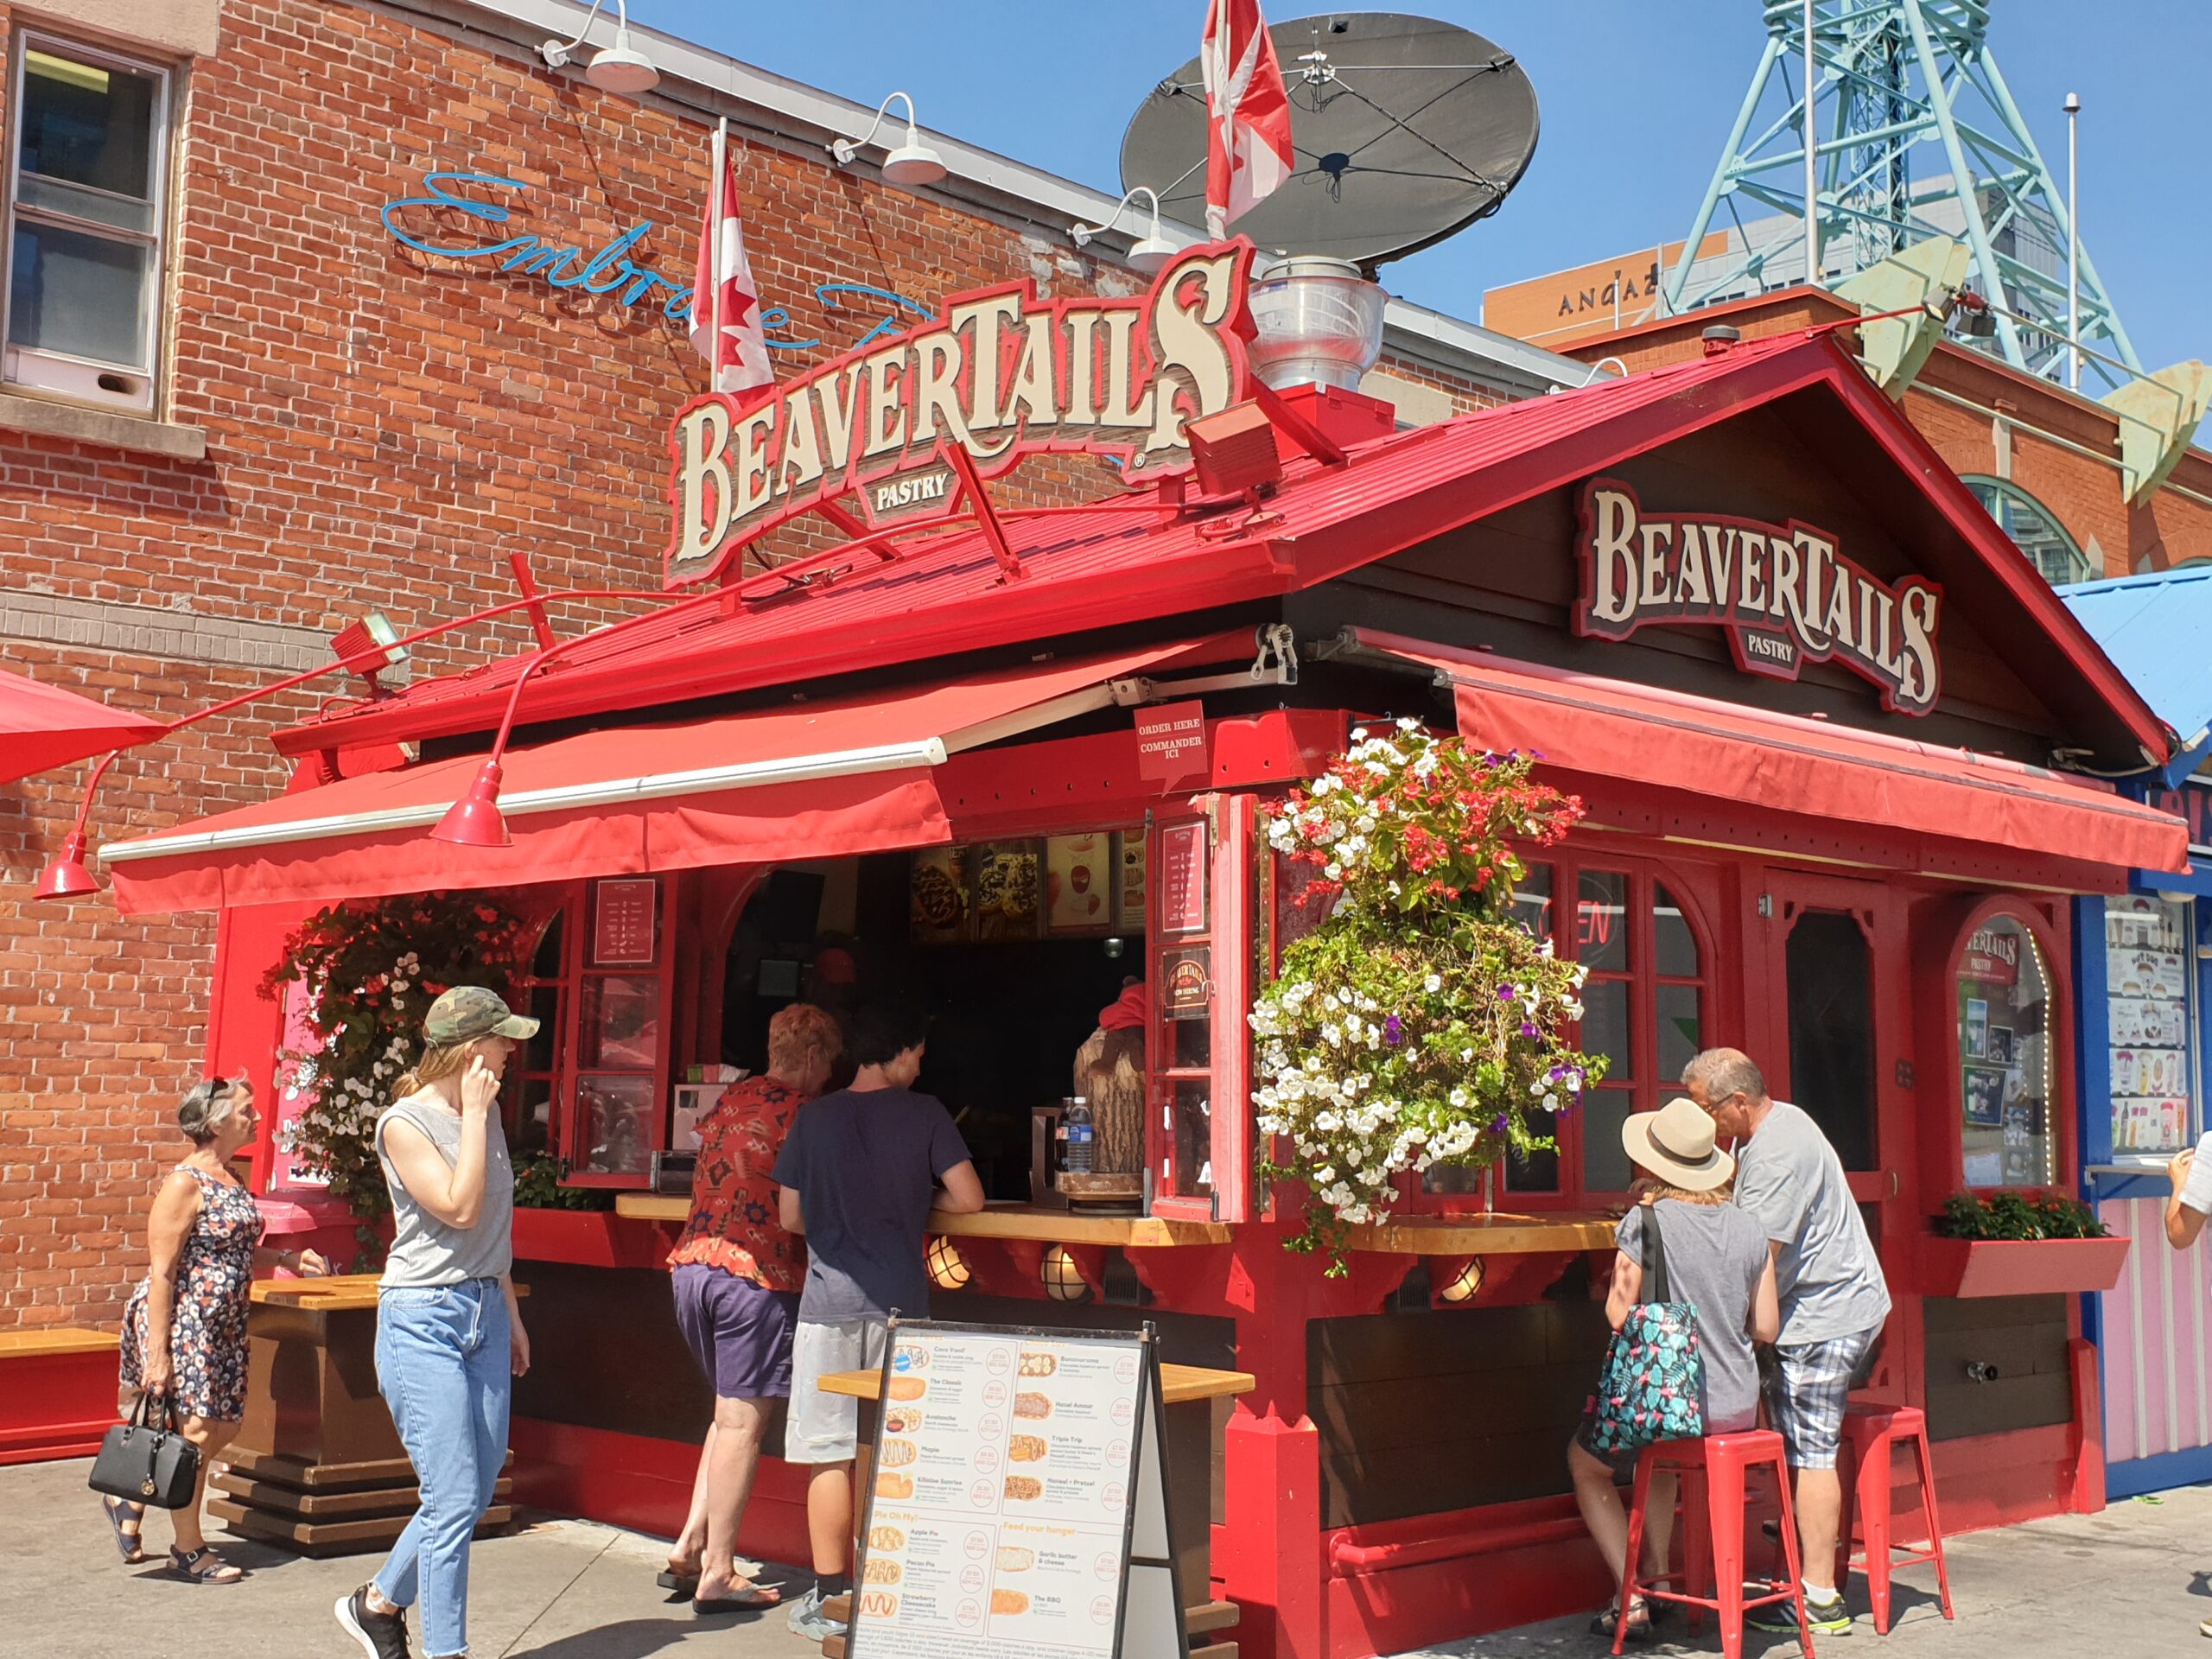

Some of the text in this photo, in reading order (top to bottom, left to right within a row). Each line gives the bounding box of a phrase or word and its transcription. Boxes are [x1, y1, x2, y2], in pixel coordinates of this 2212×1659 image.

[876, 473, 949, 512] PASTRY
[1748, 634, 1793, 664] PASTRY
[1139, 718, 1200, 735] ORDER HERE
[1141, 736, 1202, 753] COMMANDER
[1165, 749, 1179, 759] ICI
[903, 1513, 918, 1522] My!
[1004, 1522, 1077, 1536] Feed your hunger
